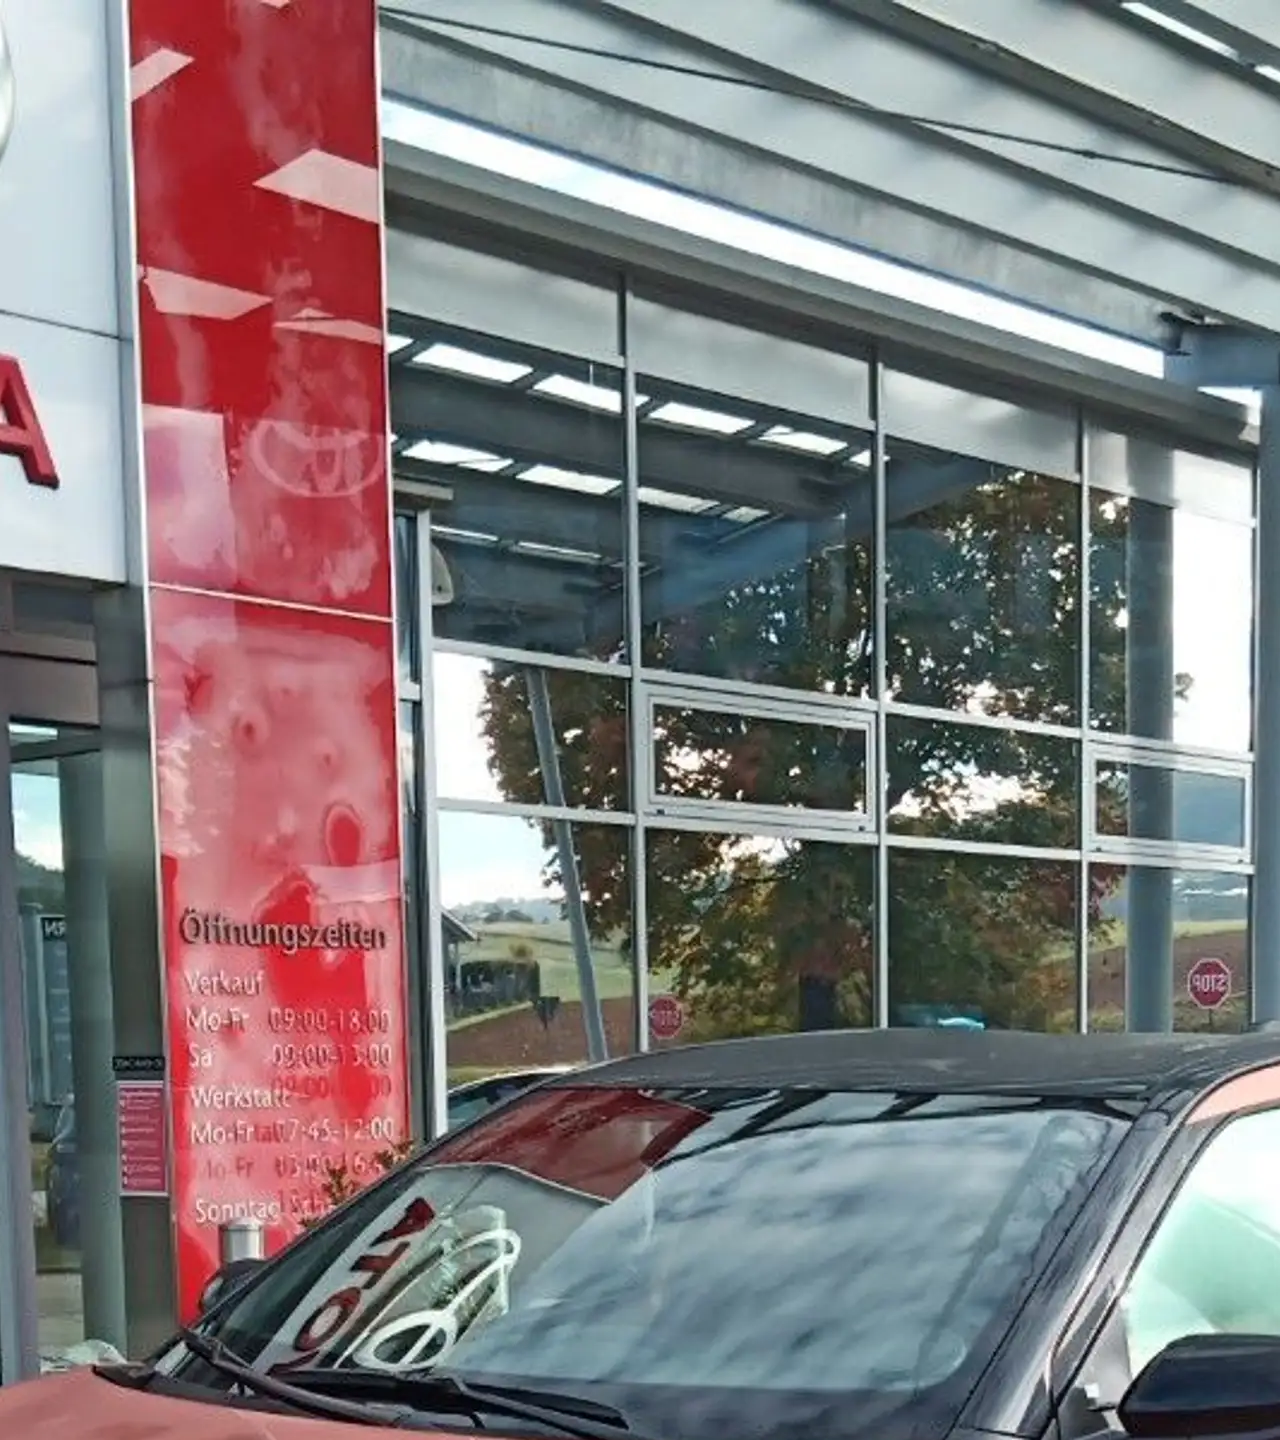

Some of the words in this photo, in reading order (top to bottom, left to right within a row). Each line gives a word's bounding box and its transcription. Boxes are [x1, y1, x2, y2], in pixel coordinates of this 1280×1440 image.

[179, 908, 388, 955] Öffnungszeiten
[184, 970, 264, 998] Verkauf
[185, 1006, 250, 1034] Mo-Fr
[188, 1043, 214, 1069] Sa
[191, 1082, 291, 1111] Werkstatt
